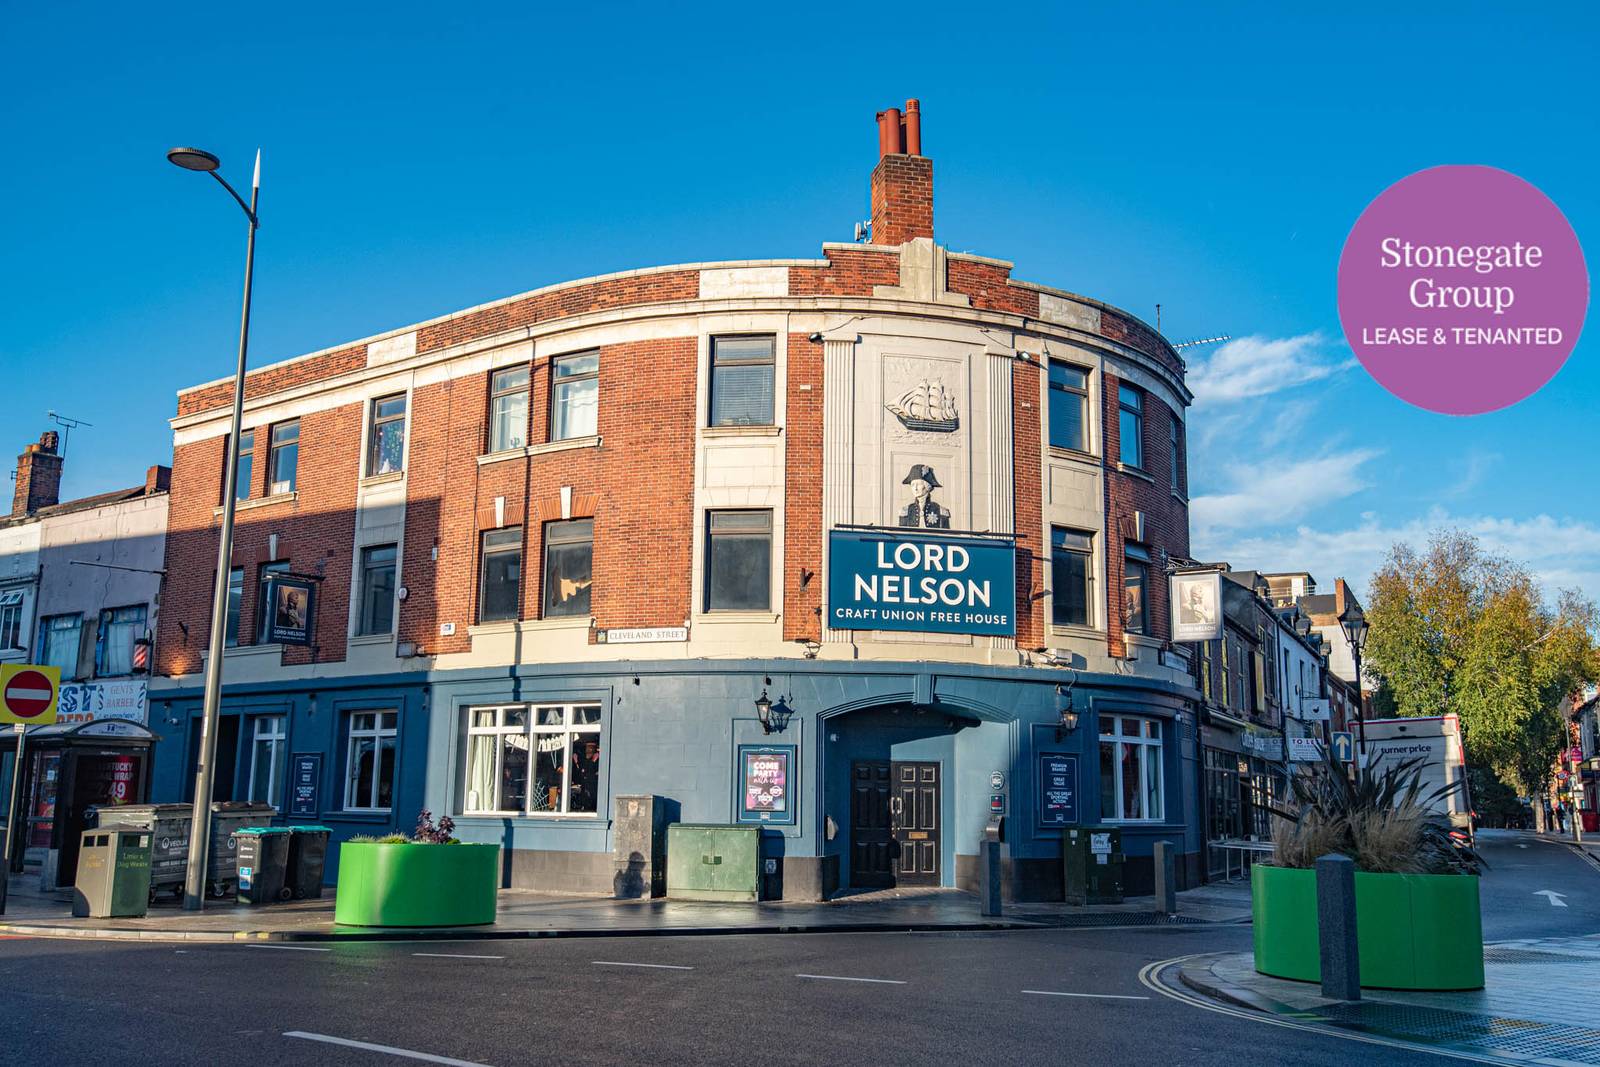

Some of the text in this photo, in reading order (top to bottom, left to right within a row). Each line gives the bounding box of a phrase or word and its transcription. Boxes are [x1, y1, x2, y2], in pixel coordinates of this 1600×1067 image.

[877, 541, 970, 572] LORD
[854, 574, 991, 608] NELSON
[836, 608, 1008, 625] CRAFT UNION FREE HOUSE
[609, 630, 684, 640] CLEVELAND STREET
[111, 685, 133, 695] GENTS
[106, 699, 134, 708] BARBER
[1381, 744, 1432, 754] turner price
[754, 762, 779, 770] COME
